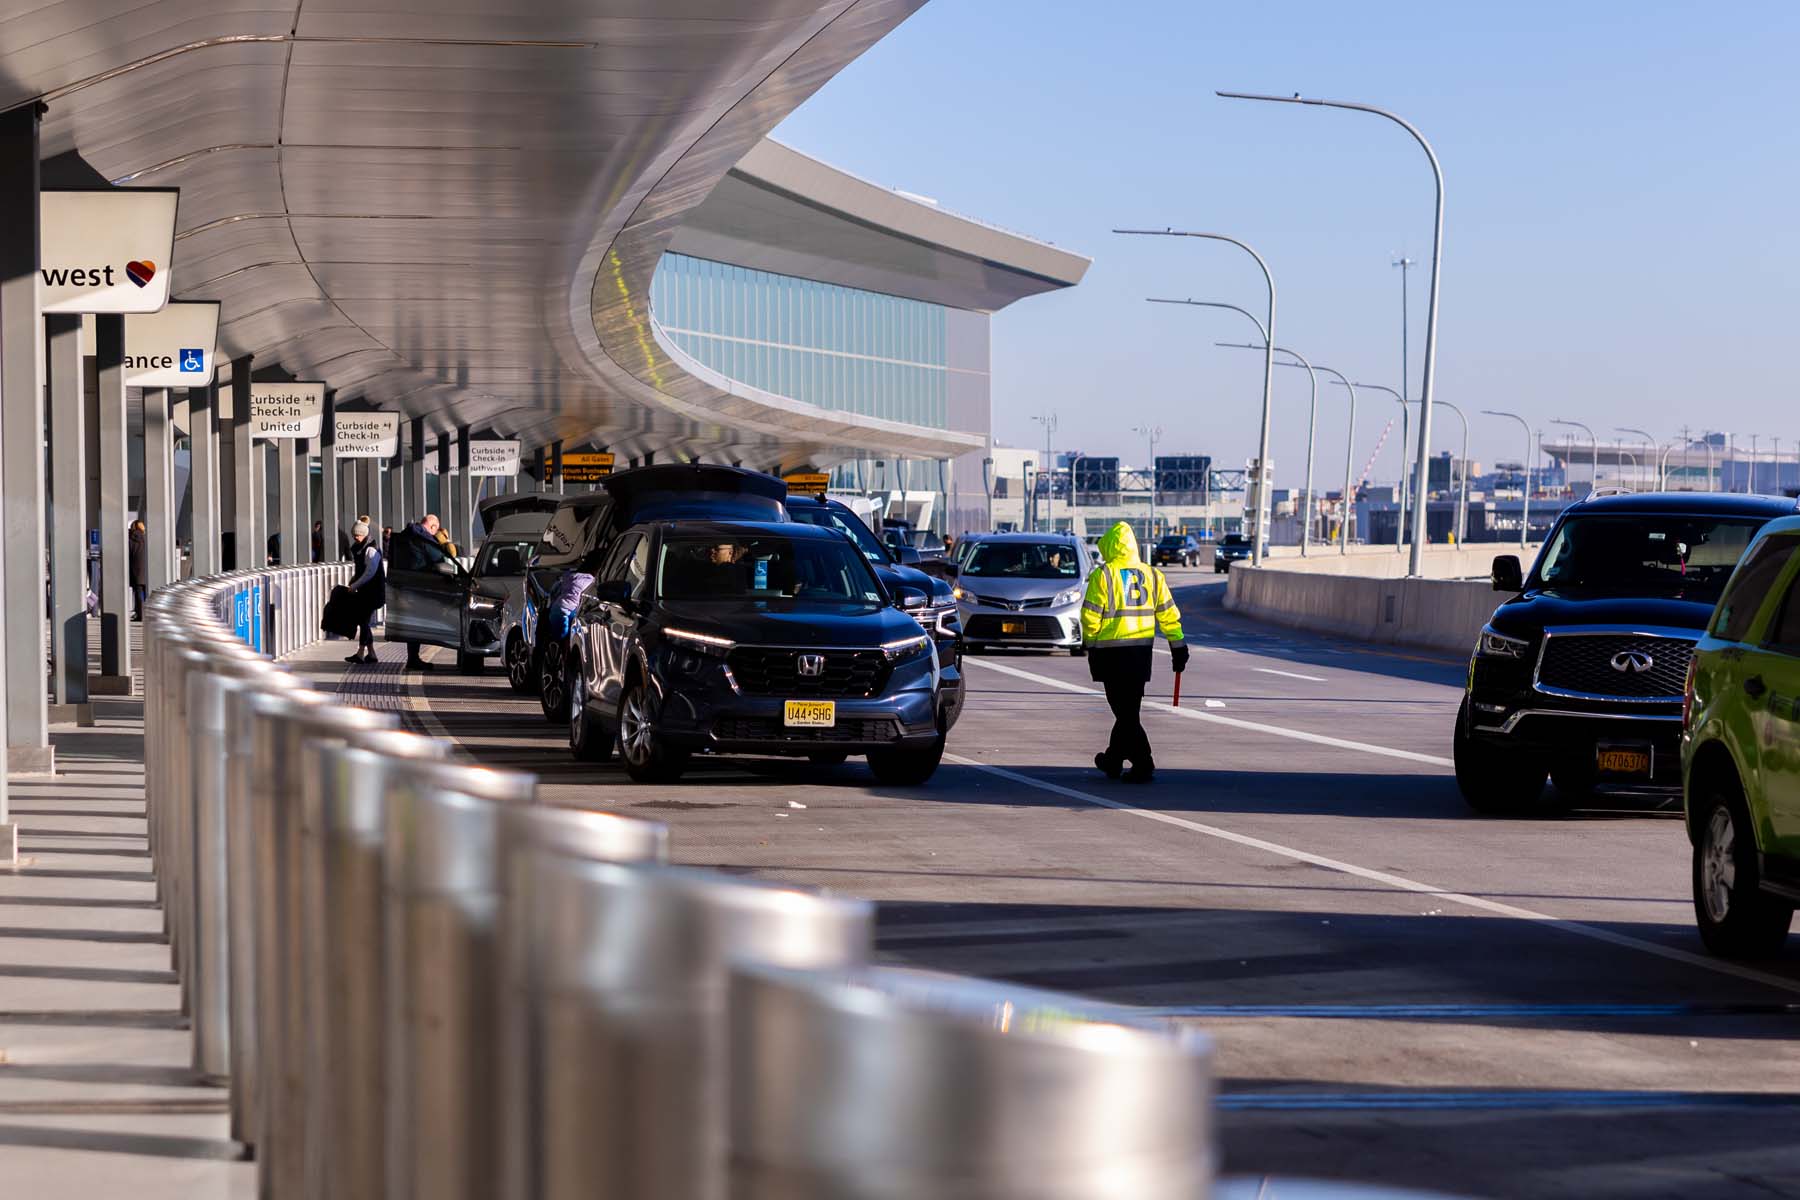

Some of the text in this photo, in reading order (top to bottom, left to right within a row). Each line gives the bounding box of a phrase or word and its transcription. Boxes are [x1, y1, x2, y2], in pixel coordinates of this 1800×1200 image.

[42, 265, 115, 287] west
[125, 354, 173, 369] ance
[250, 405, 301, 417] Check-In
[260, 421, 301, 432] United
[336, 421, 380, 431] Curbside
[337, 431, 380, 440] Check-In
[471, 447, 505, 455] Curbside
[1119, 568, 1149, 607] B
